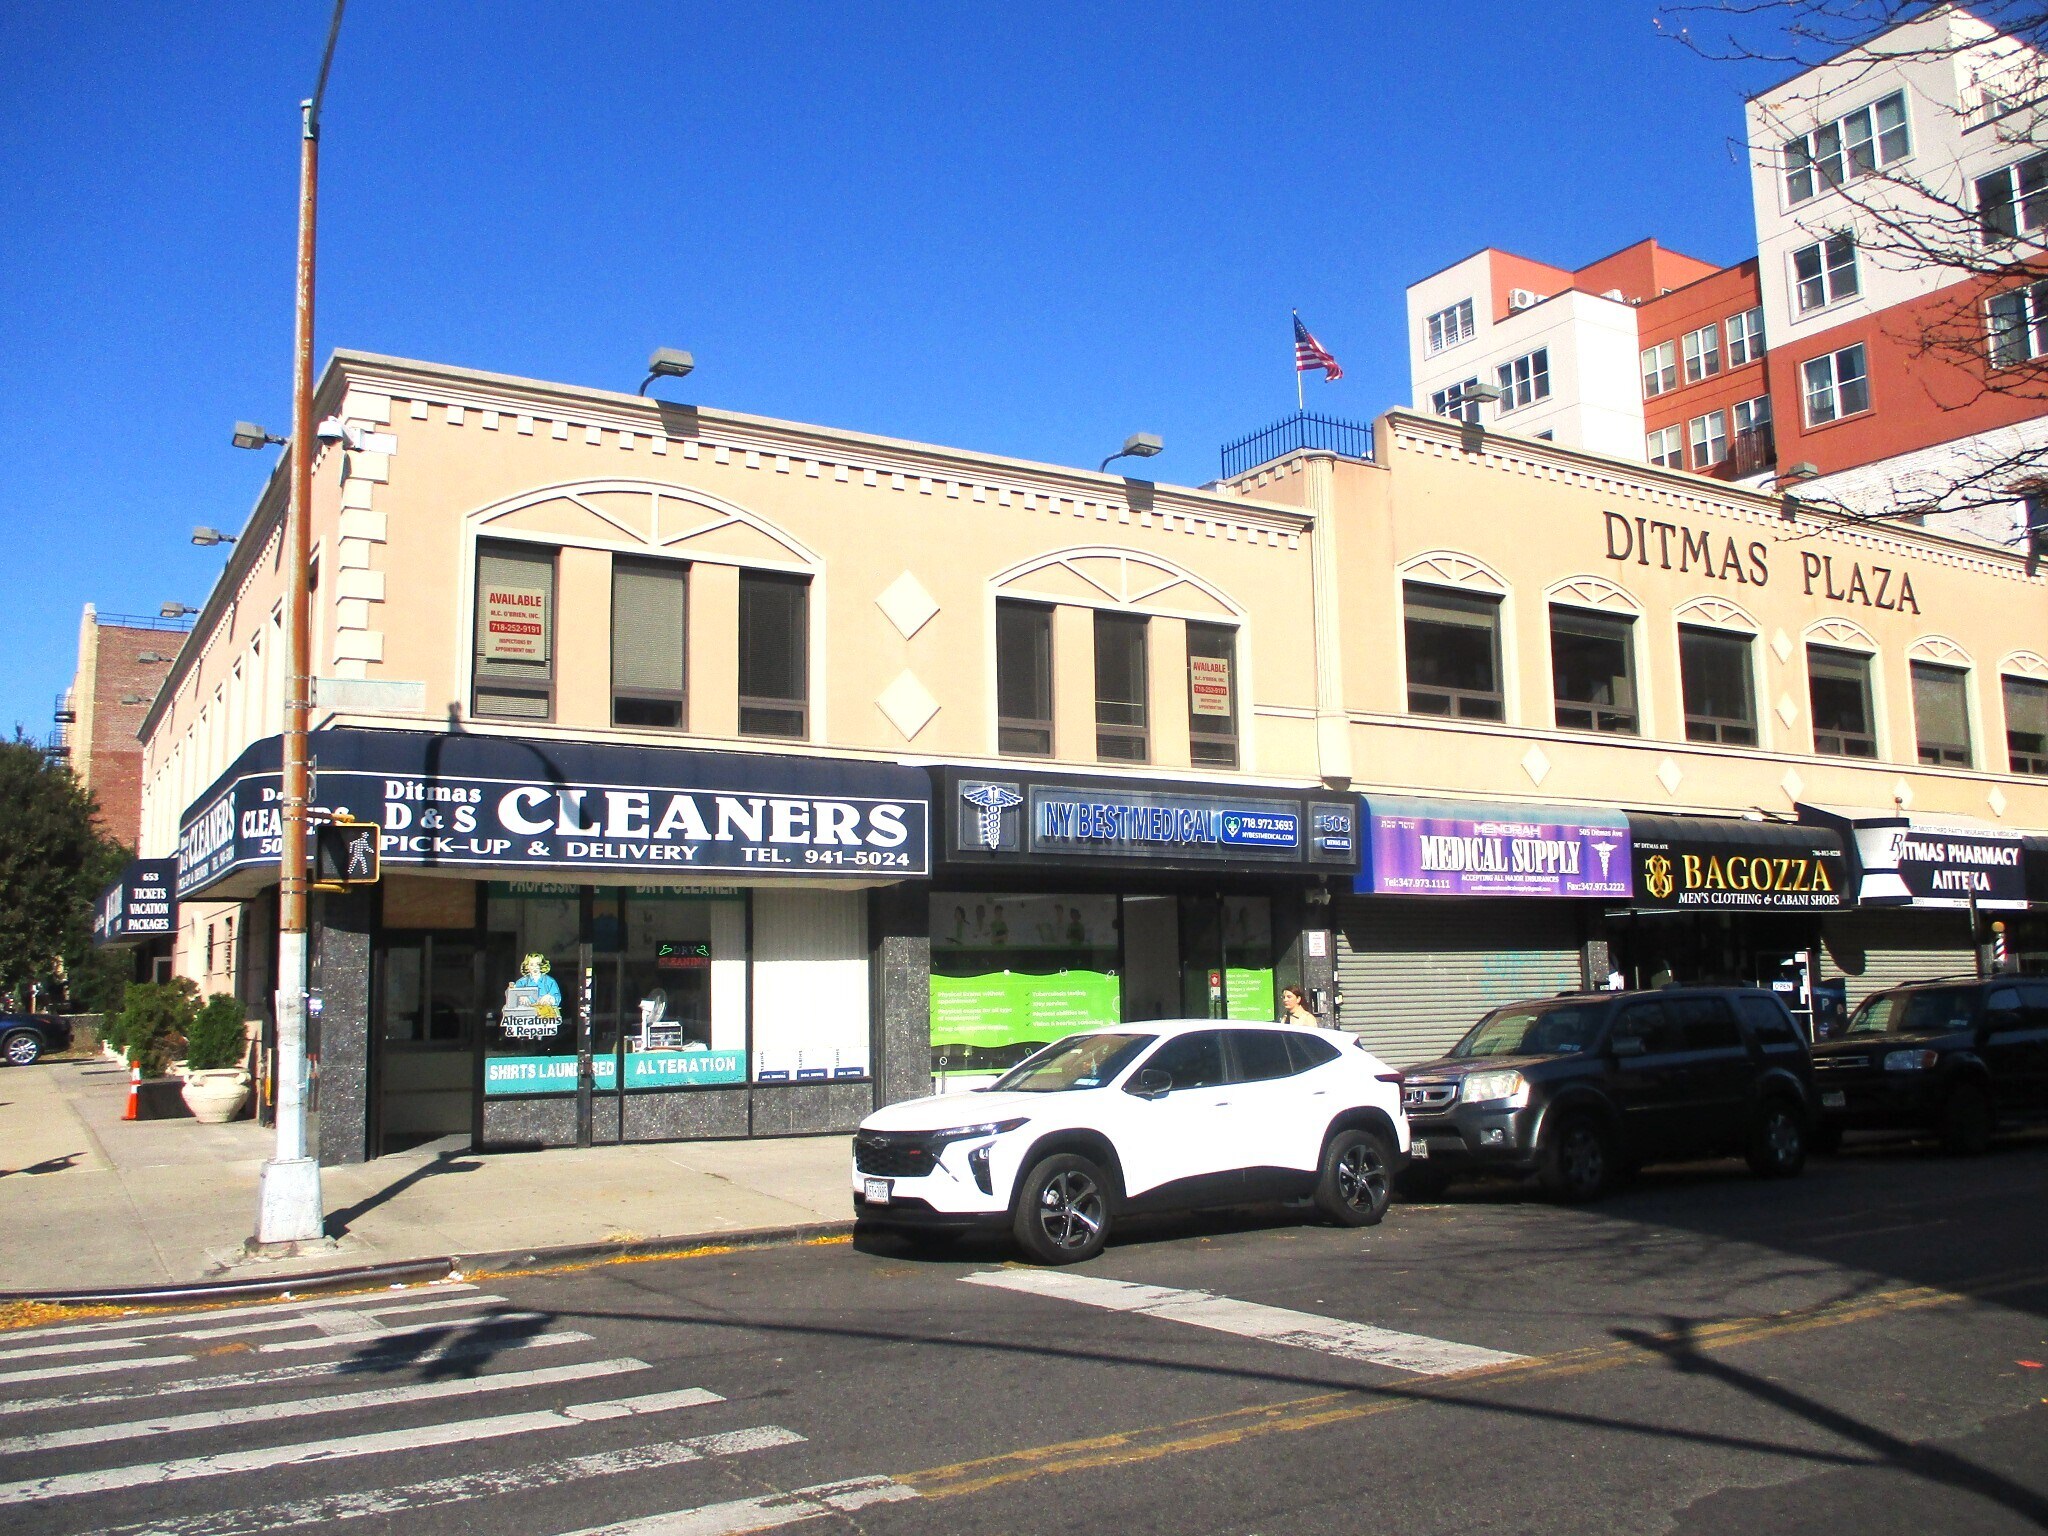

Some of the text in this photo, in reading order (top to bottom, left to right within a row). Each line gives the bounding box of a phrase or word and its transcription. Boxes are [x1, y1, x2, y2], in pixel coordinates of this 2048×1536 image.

[1603, 510, 1921, 615] DITMAS PLAZA
[489, 593, 542, 607] AVAILABLE
[491, 623, 540, 633] 718-252-9191
[1193, 661, 1226, 673] AVAILABLE
[385, 780, 482, 803] Ditmas
[384, 802, 477, 833] D & S
[497, 786, 908, 848] CLEANERS
[1044, 802, 1218, 844] NY BEST MEDICAL
[1241, 817, 1294, 831] 718.972.3693
[1323, 815, 1350, 833] 503
[189, 791, 236, 868] CLEANERS
[1242, 832, 1294, 841] NYBESTMEDICAL.COM
[1473, 823, 1541, 838] MENORAH
[1579, 828, 1590, 836] 505
[1591, 829, 1611, 837] Ditmas
[380, 834, 910, 867] PICK-UP & DELIVERY TEL. 941-5024
[1420, 835, 1581, 874] MEDICAL SUPPLY
[1948, 844, 2020, 866] PHARMACY
[143, 872, 159, 881] 653
[1461, 874, 1493, 882] ACCEPTING
[1525, 875, 1560, 883] INSURANCES
[1682, 854, 1833, 892] BAGOZZA
[133, 887, 167, 900] TICKETS
[1679, 891, 1840, 906] MEN'S CLOTHING & CABANI SHOES
[129, 902, 169, 915] VACATION
[128, 918, 169, 931] PACKAGES
[502, 1014, 562, 1026] Alterations
[506, 1026, 557, 1037] & Repairs
[489, 1063, 536, 1080] SHIRTS
[636, 1056, 736, 1075] ALTERATION
